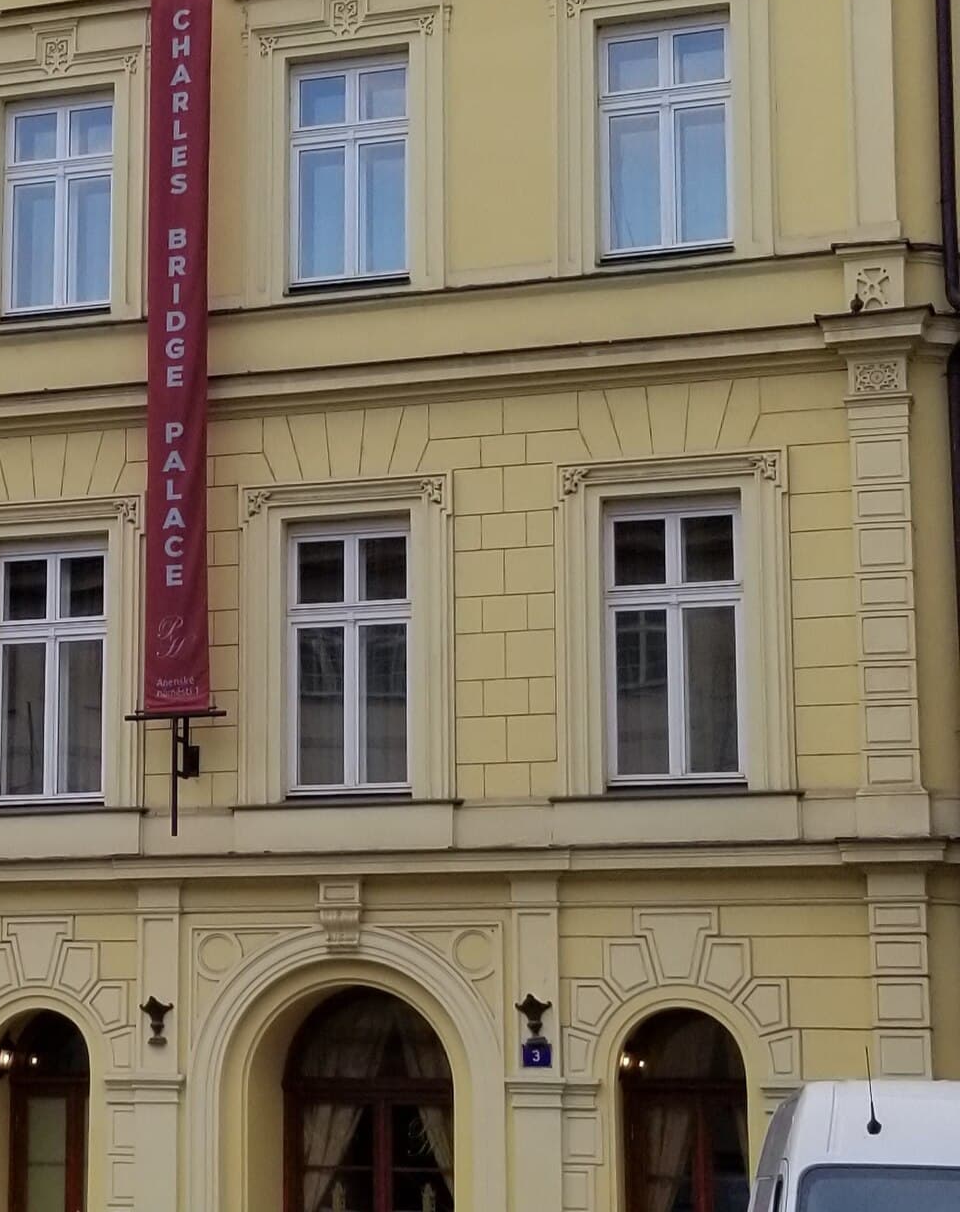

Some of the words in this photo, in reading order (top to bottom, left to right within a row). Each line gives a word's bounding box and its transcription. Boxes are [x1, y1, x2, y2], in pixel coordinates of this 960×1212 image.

[170, 8, 191, 195] CHARLES
[164, 228, 187, 388] BRIDGE
[162, 421, 186, 587] PALACE
[532, 1049, 540, 1062] 3
